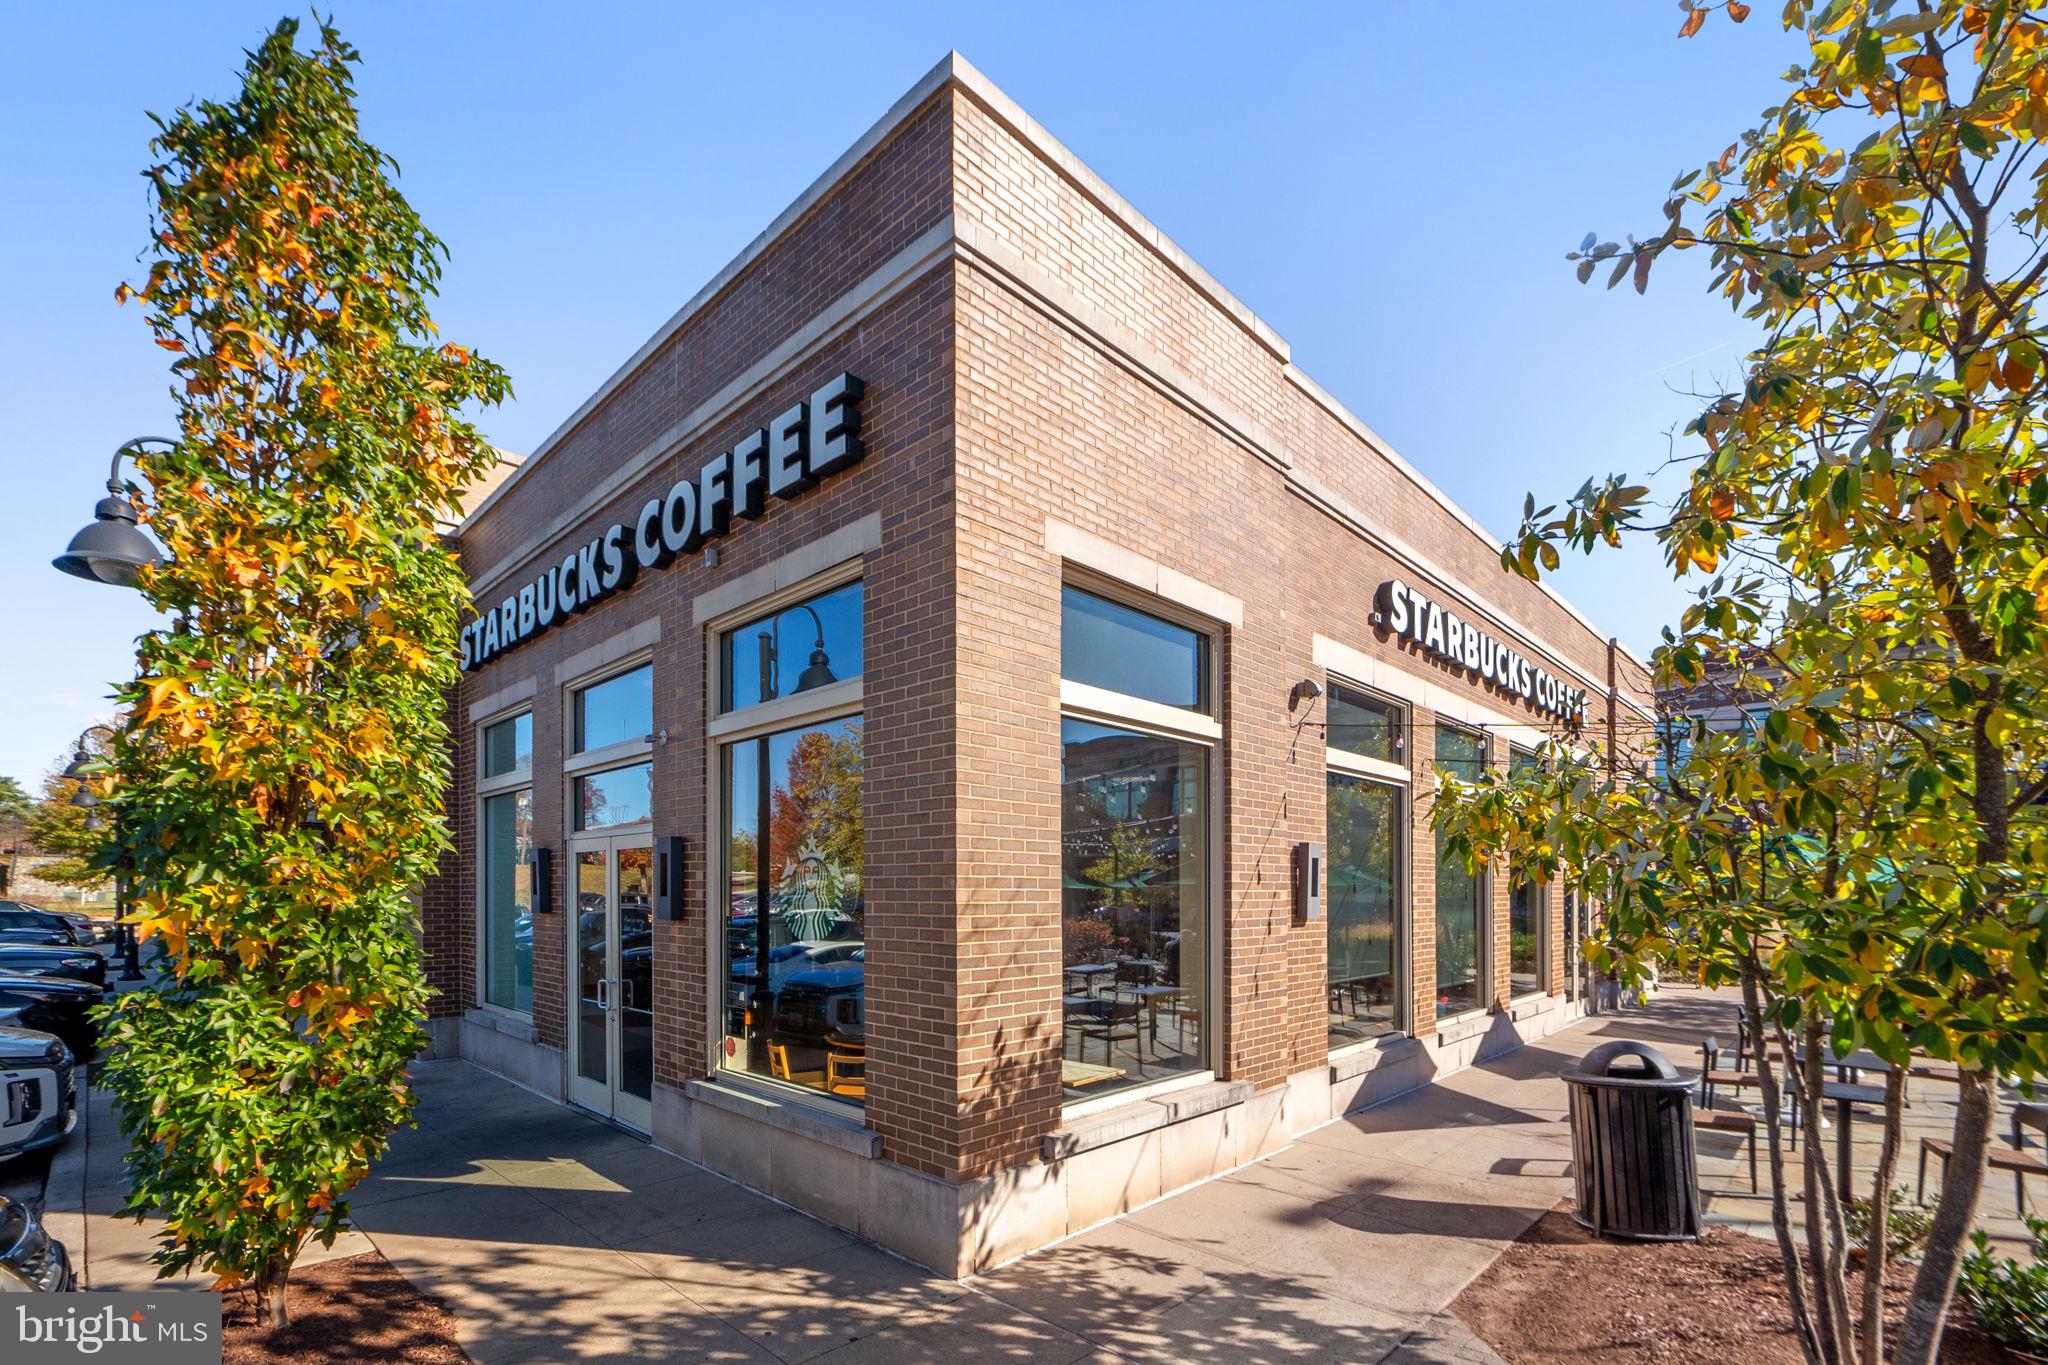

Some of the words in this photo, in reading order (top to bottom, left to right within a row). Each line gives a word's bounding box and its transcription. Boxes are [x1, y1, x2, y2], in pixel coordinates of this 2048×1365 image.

[459, 523, 627, 671] STARBUCKS
[635, 371, 851, 568] COFFEE
[1390, 579, 1532, 699] STARBUCKS
